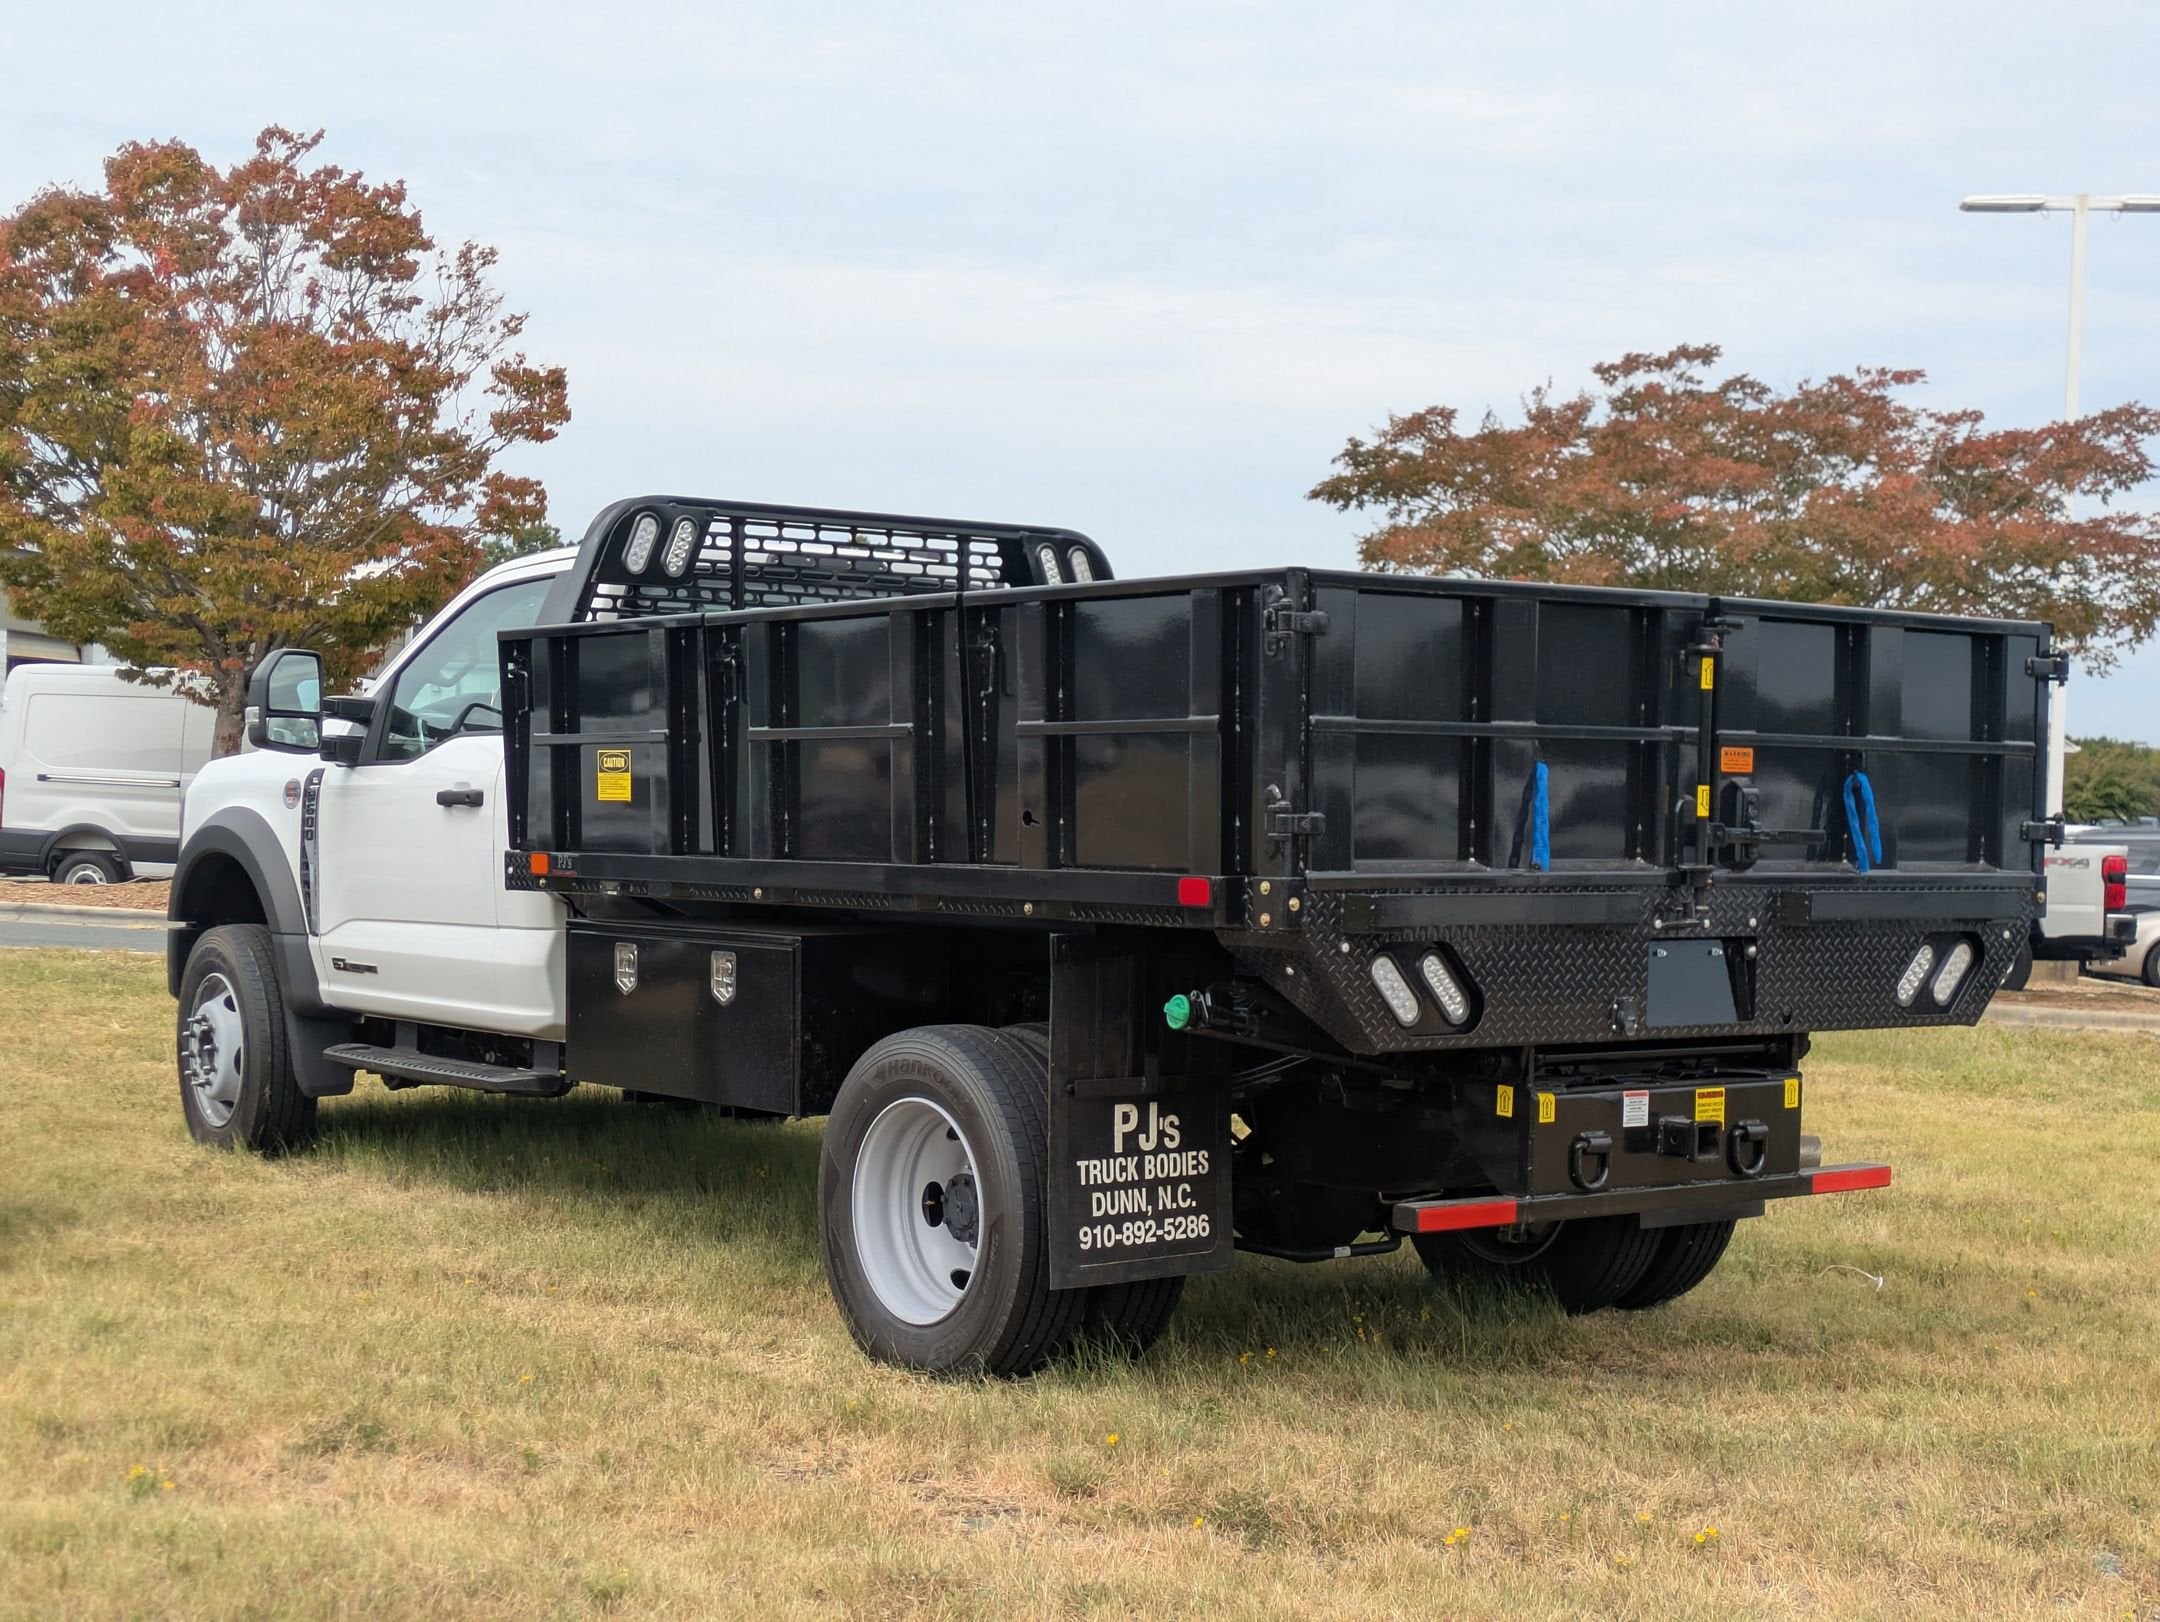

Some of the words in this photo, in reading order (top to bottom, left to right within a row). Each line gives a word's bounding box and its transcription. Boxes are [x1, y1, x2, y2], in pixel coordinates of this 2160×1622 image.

[1114, 1101, 1181, 1153] PJ's
[1077, 1156, 1139, 1186] TRUCK
[1144, 1150, 1209, 1180] BODIES
[1092, 1187, 1152, 1217] DUNN,
[1158, 1183, 1197, 1211] N.C.
[1079, 1214, 1210, 1250] 910-892-5286
